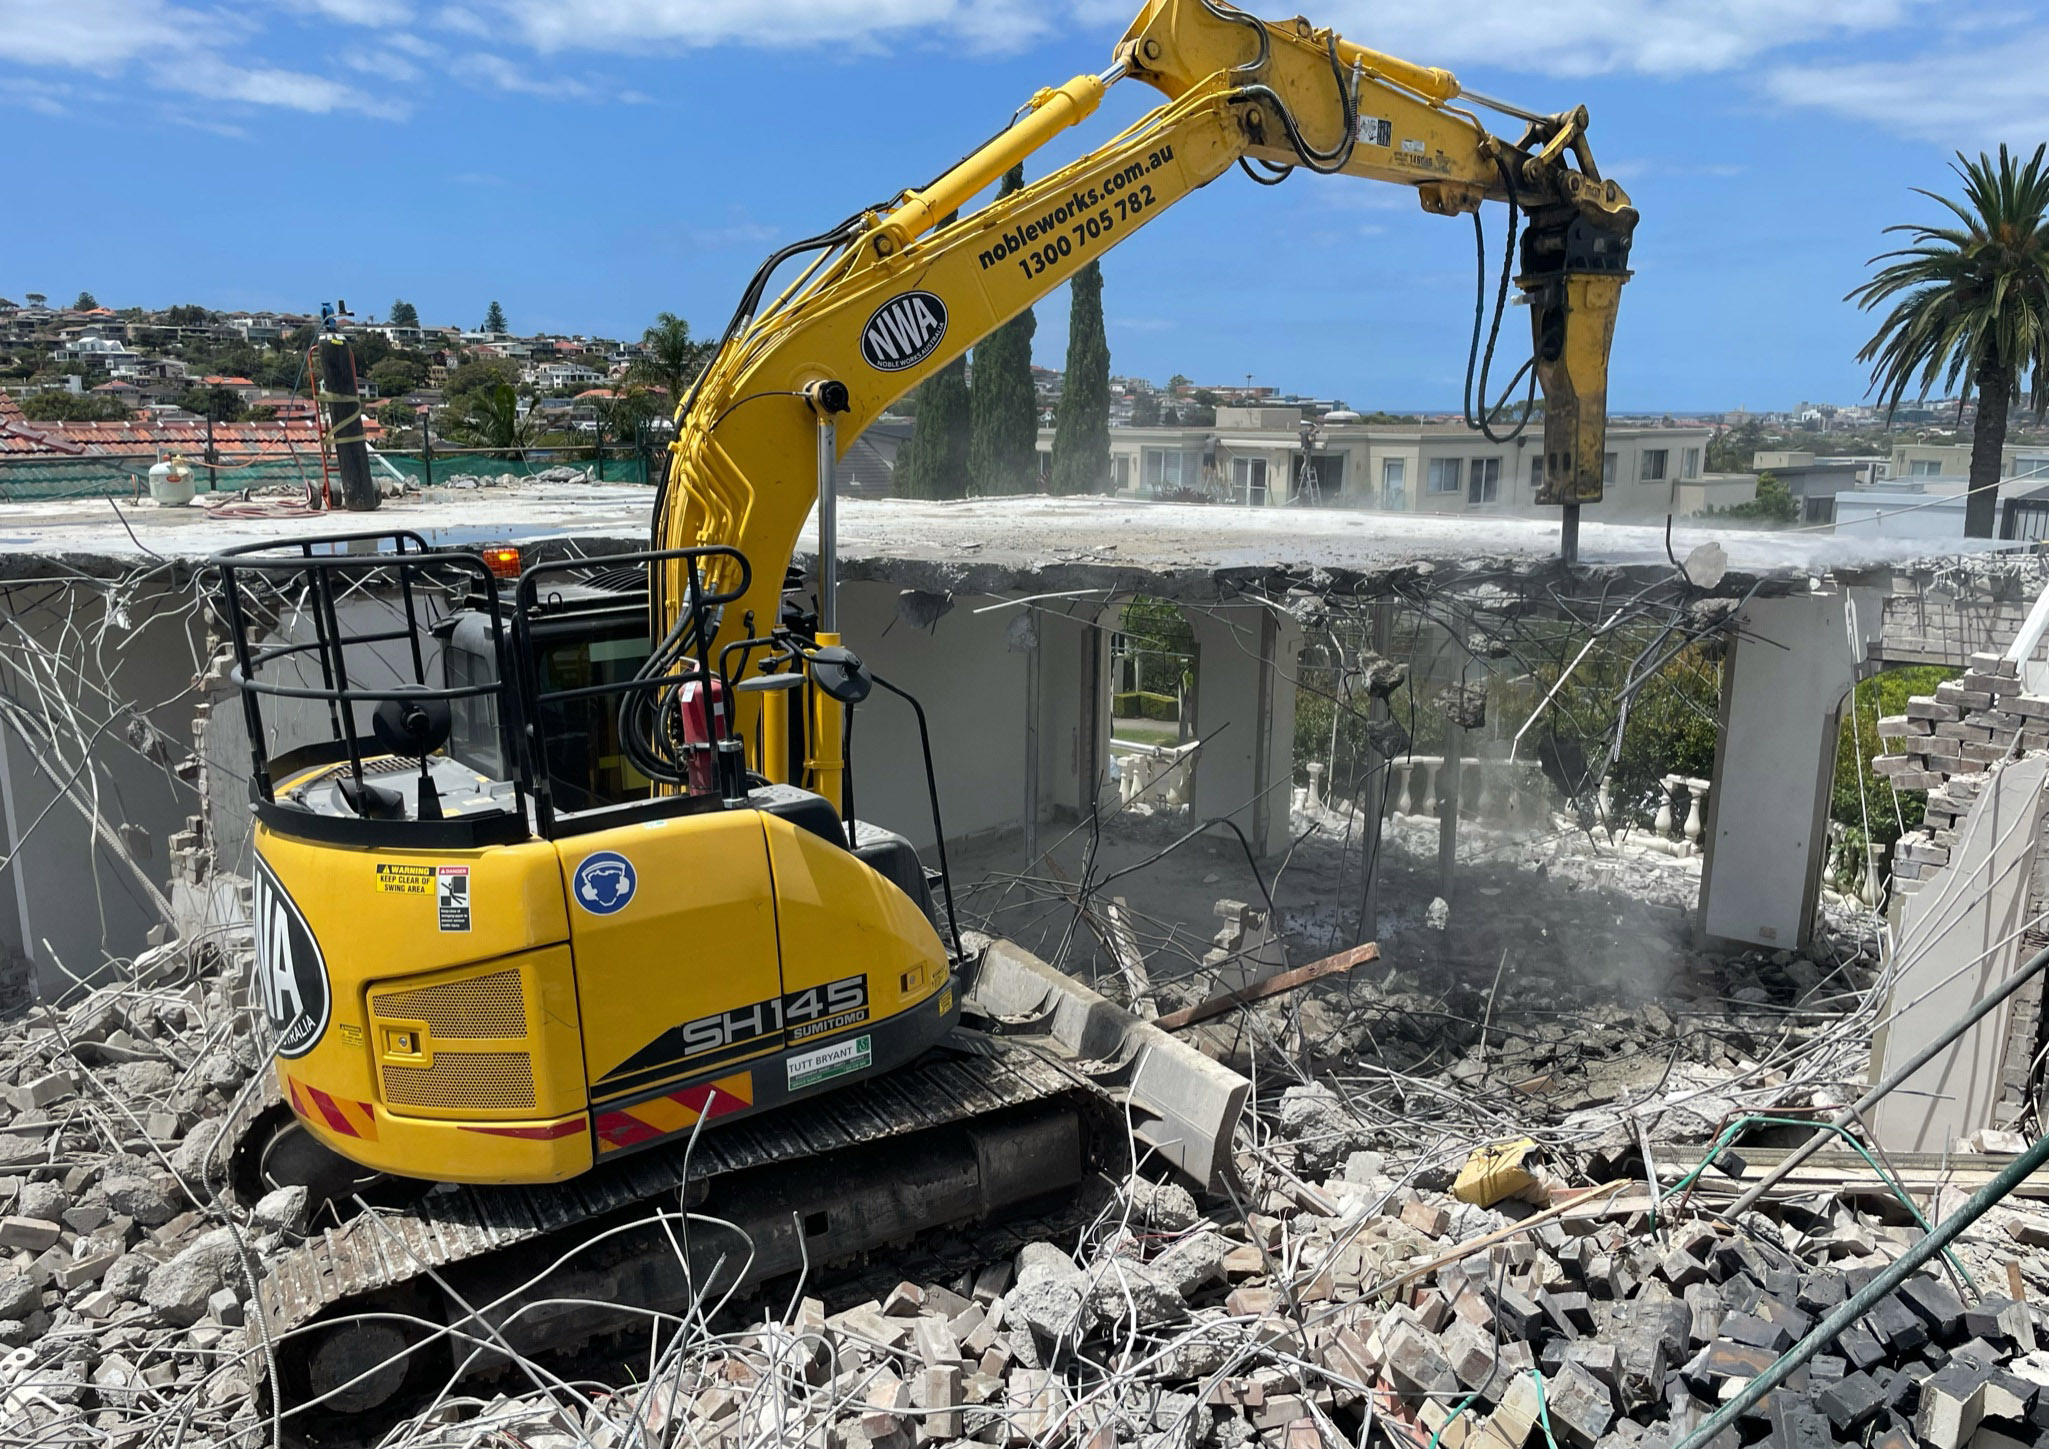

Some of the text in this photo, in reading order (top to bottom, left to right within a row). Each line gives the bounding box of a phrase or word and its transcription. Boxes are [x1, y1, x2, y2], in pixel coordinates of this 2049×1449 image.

[978, 144, 1174, 271] nobleworks.com.au
[1018, 184, 1157, 280] 1300 705 782
[867, 297, 938, 361] NWA
[877, 322, 945, 368] NOBLE WORKS AUSTRALIA
[380, 875, 431, 885] KEEP CLEAR OF
[384, 884, 426, 894] SWING AREA
[391, 866, 430, 875] WARNING
[682, 976, 864, 1056] SH145
[793, 1010, 865, 1039] SUMITOMO
[788, 1058, 813, 1073] TUTT
[815, 1046, 853, 1066] BRYANT
